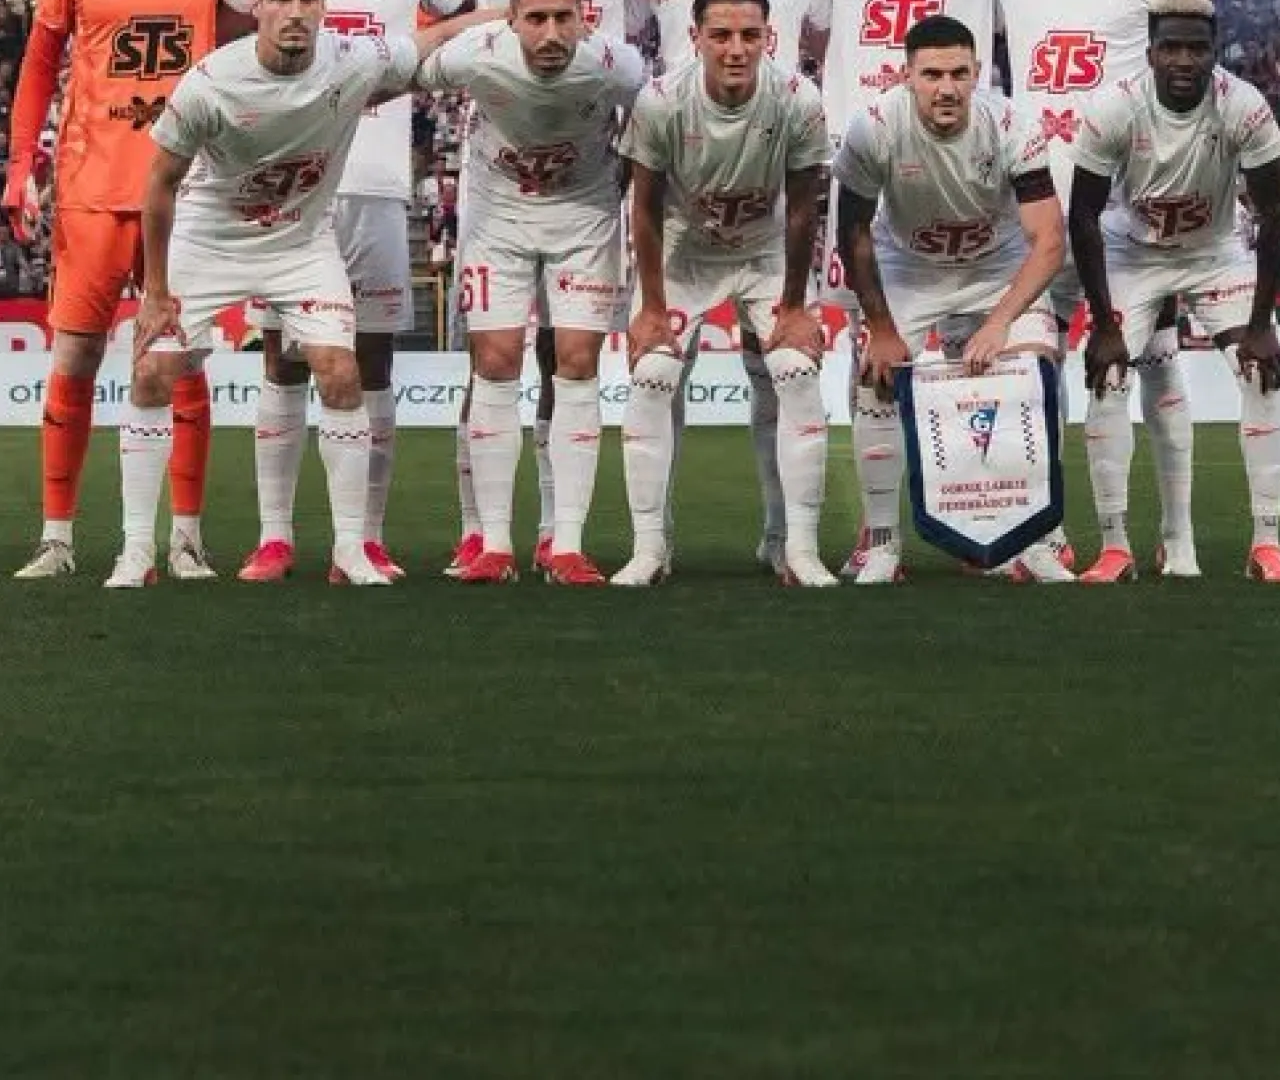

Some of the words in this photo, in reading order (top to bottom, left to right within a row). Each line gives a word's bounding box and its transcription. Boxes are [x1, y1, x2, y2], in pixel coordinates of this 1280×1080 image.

[107, 15, 195, 81] STS
[1027, 31, 1107, 94] STS
[910, 218, 996, 260] STS
